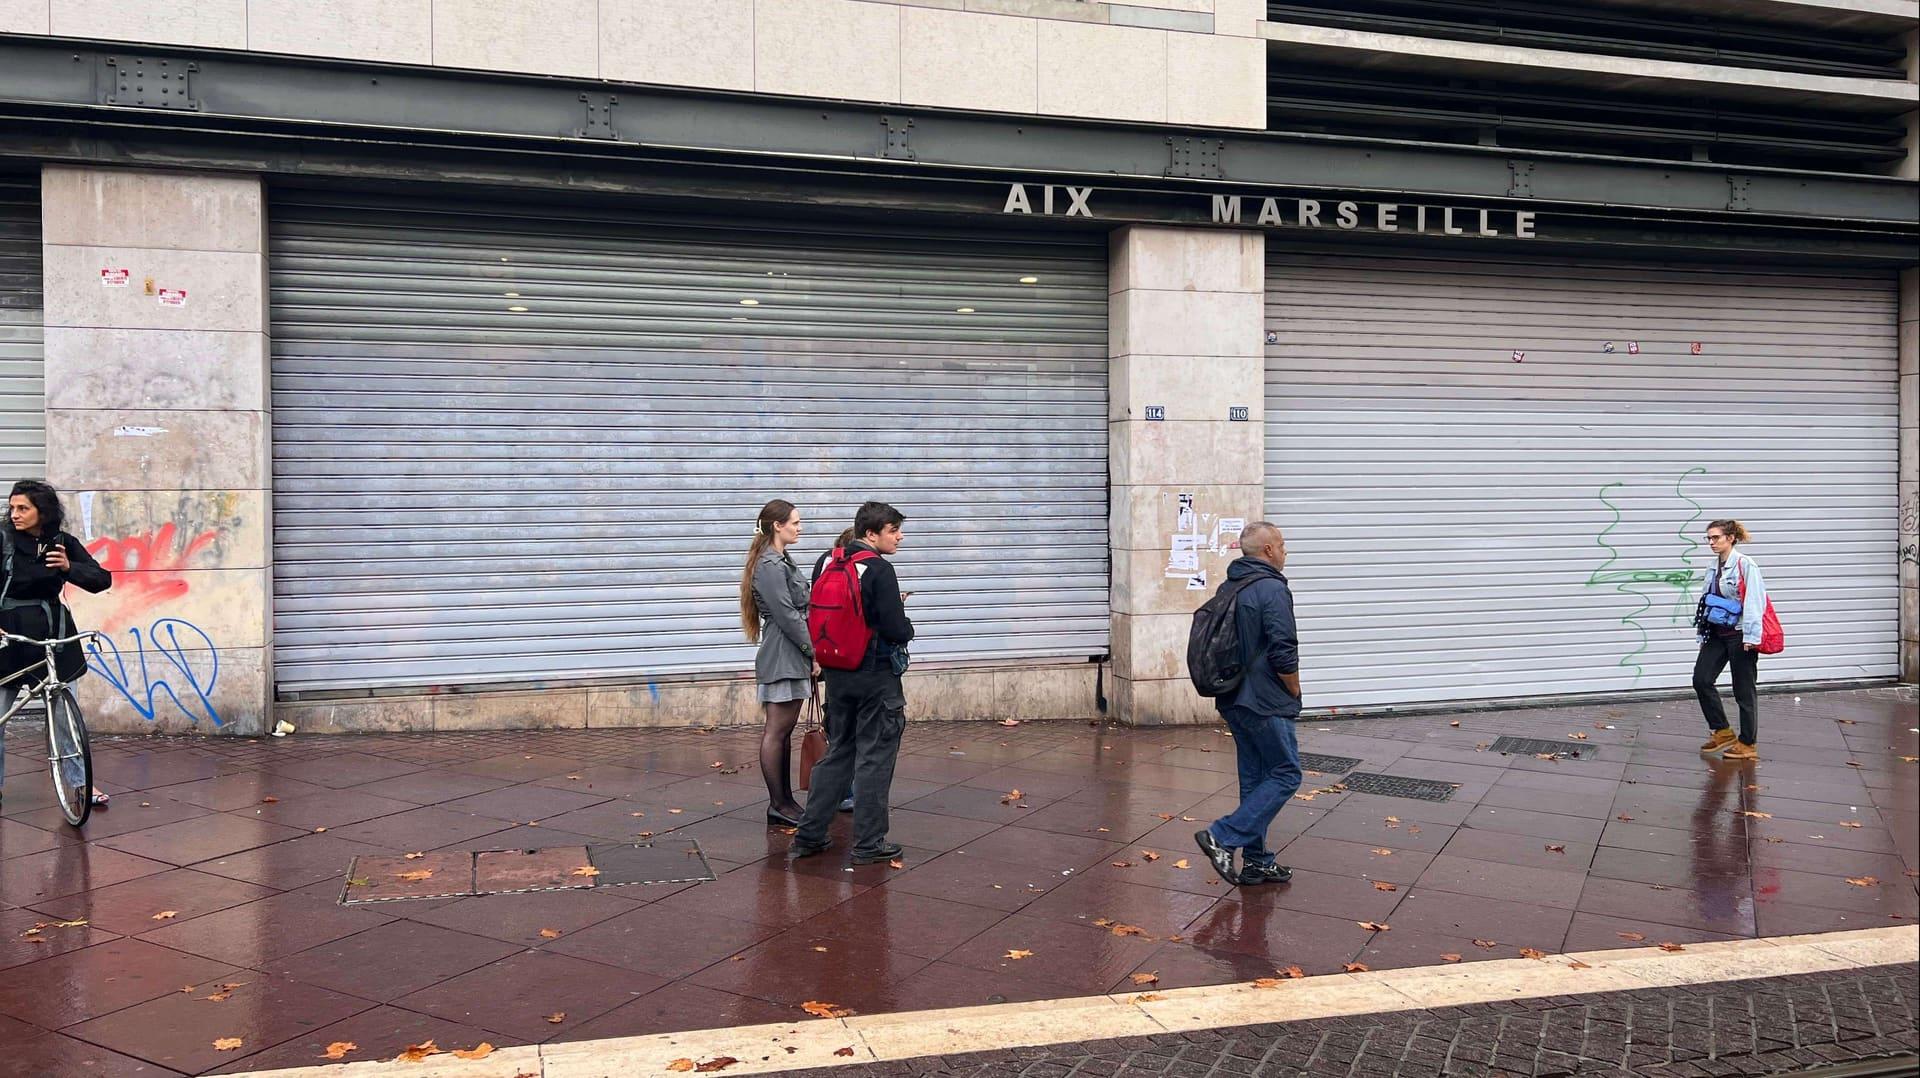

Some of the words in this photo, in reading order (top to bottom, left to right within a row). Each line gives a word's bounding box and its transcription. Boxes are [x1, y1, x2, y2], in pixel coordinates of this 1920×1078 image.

[1003, 183, 1095, 219] AIX
[1211, 194, 1537, 240] MARSEILLE
[1147, 408, 1162, 418] 114
[1232, 409, 1246, 418] 110
